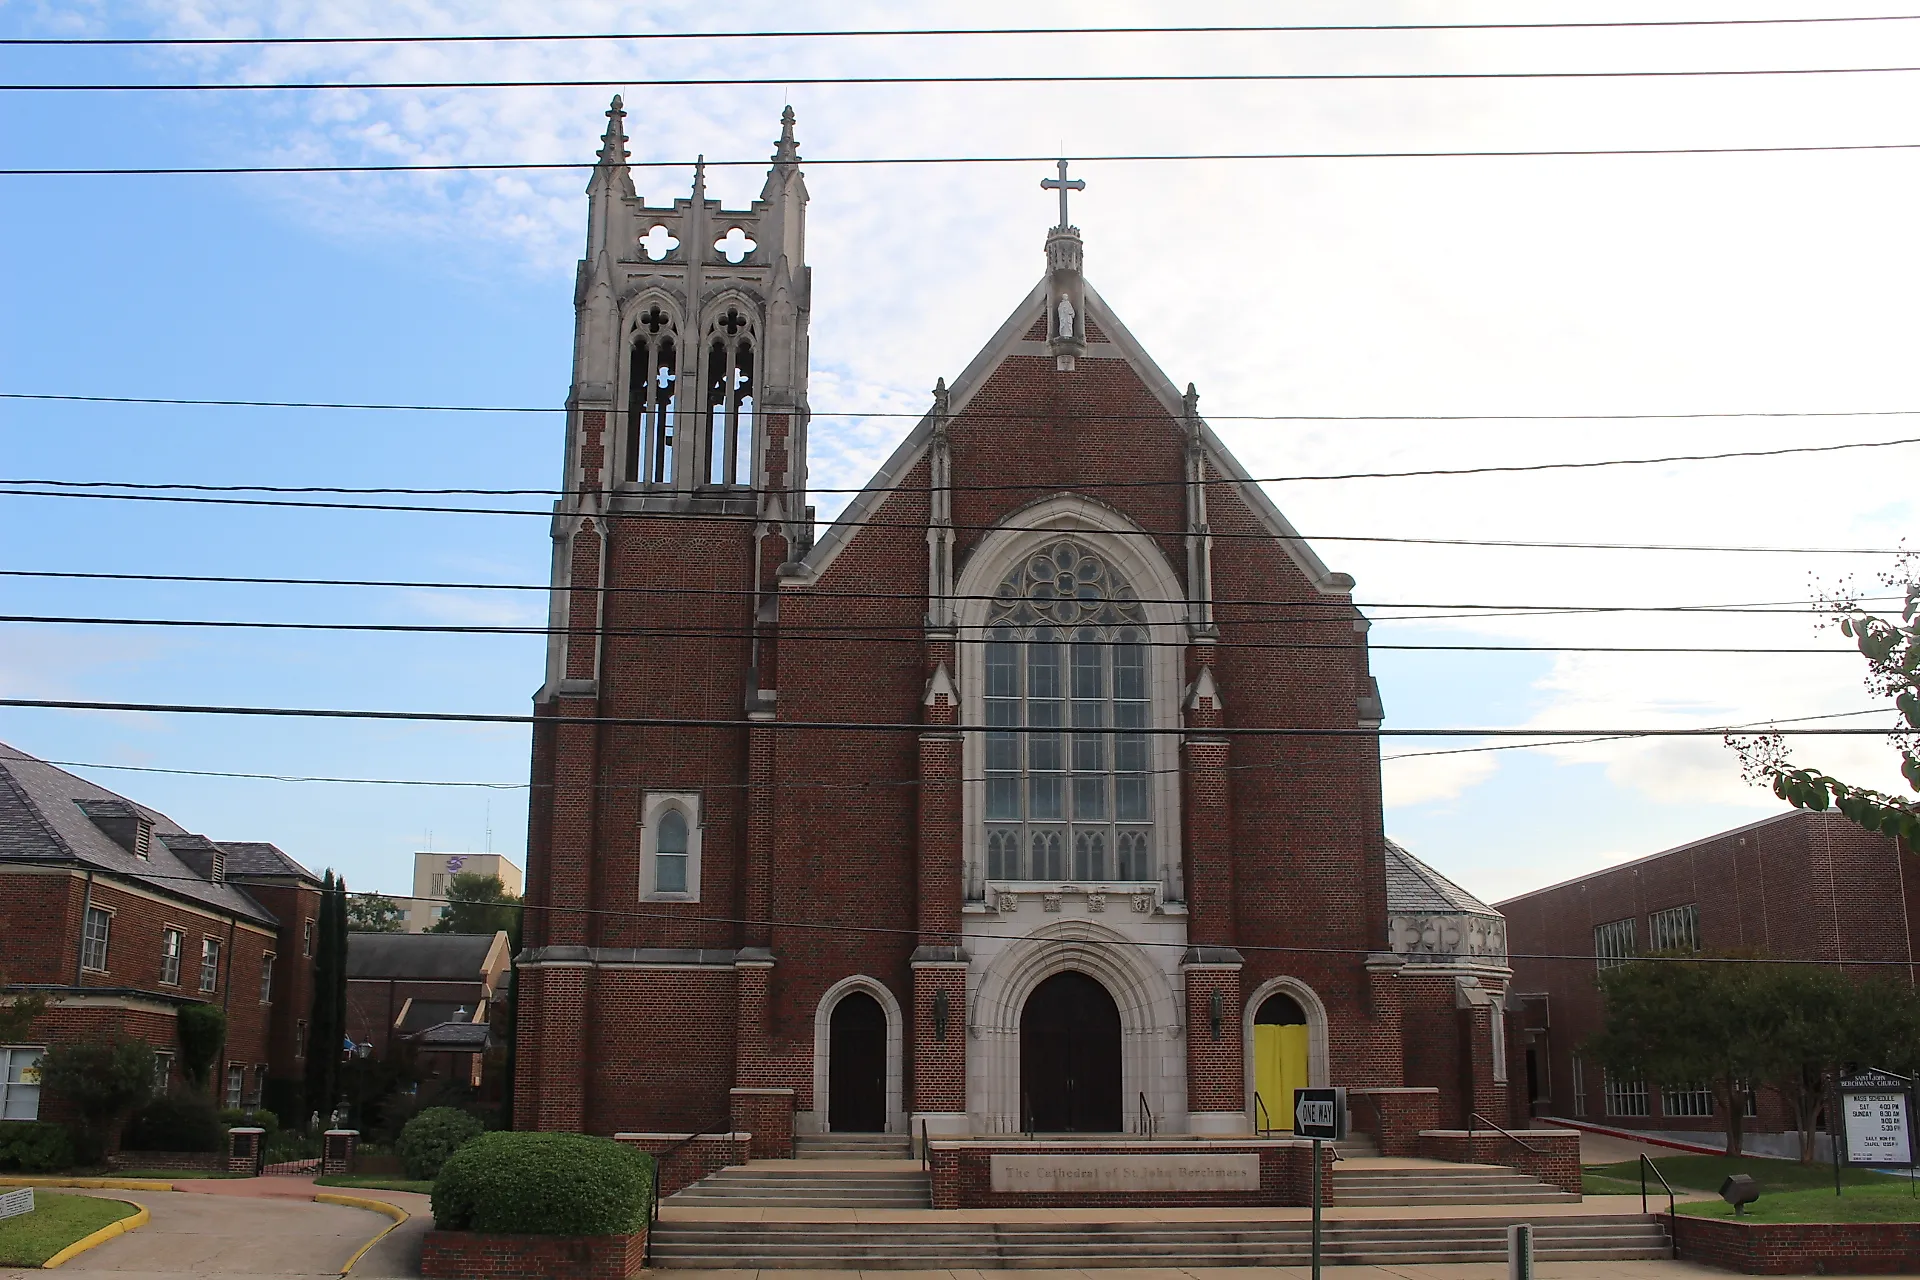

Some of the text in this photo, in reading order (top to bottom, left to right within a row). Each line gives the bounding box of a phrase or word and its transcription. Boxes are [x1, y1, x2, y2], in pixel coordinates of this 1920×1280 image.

[1303, 1104, 1332, 1123] ONE WAY
[1005, 1167, 1030, 1178] The
[1037, 1167, 1099, 1178] Cathedral
[1105, 1167, 1118, 1178] of
[1141, 1167, 1172, 1179] John
[1178, 1167, 1248, 1178] Berchmans
